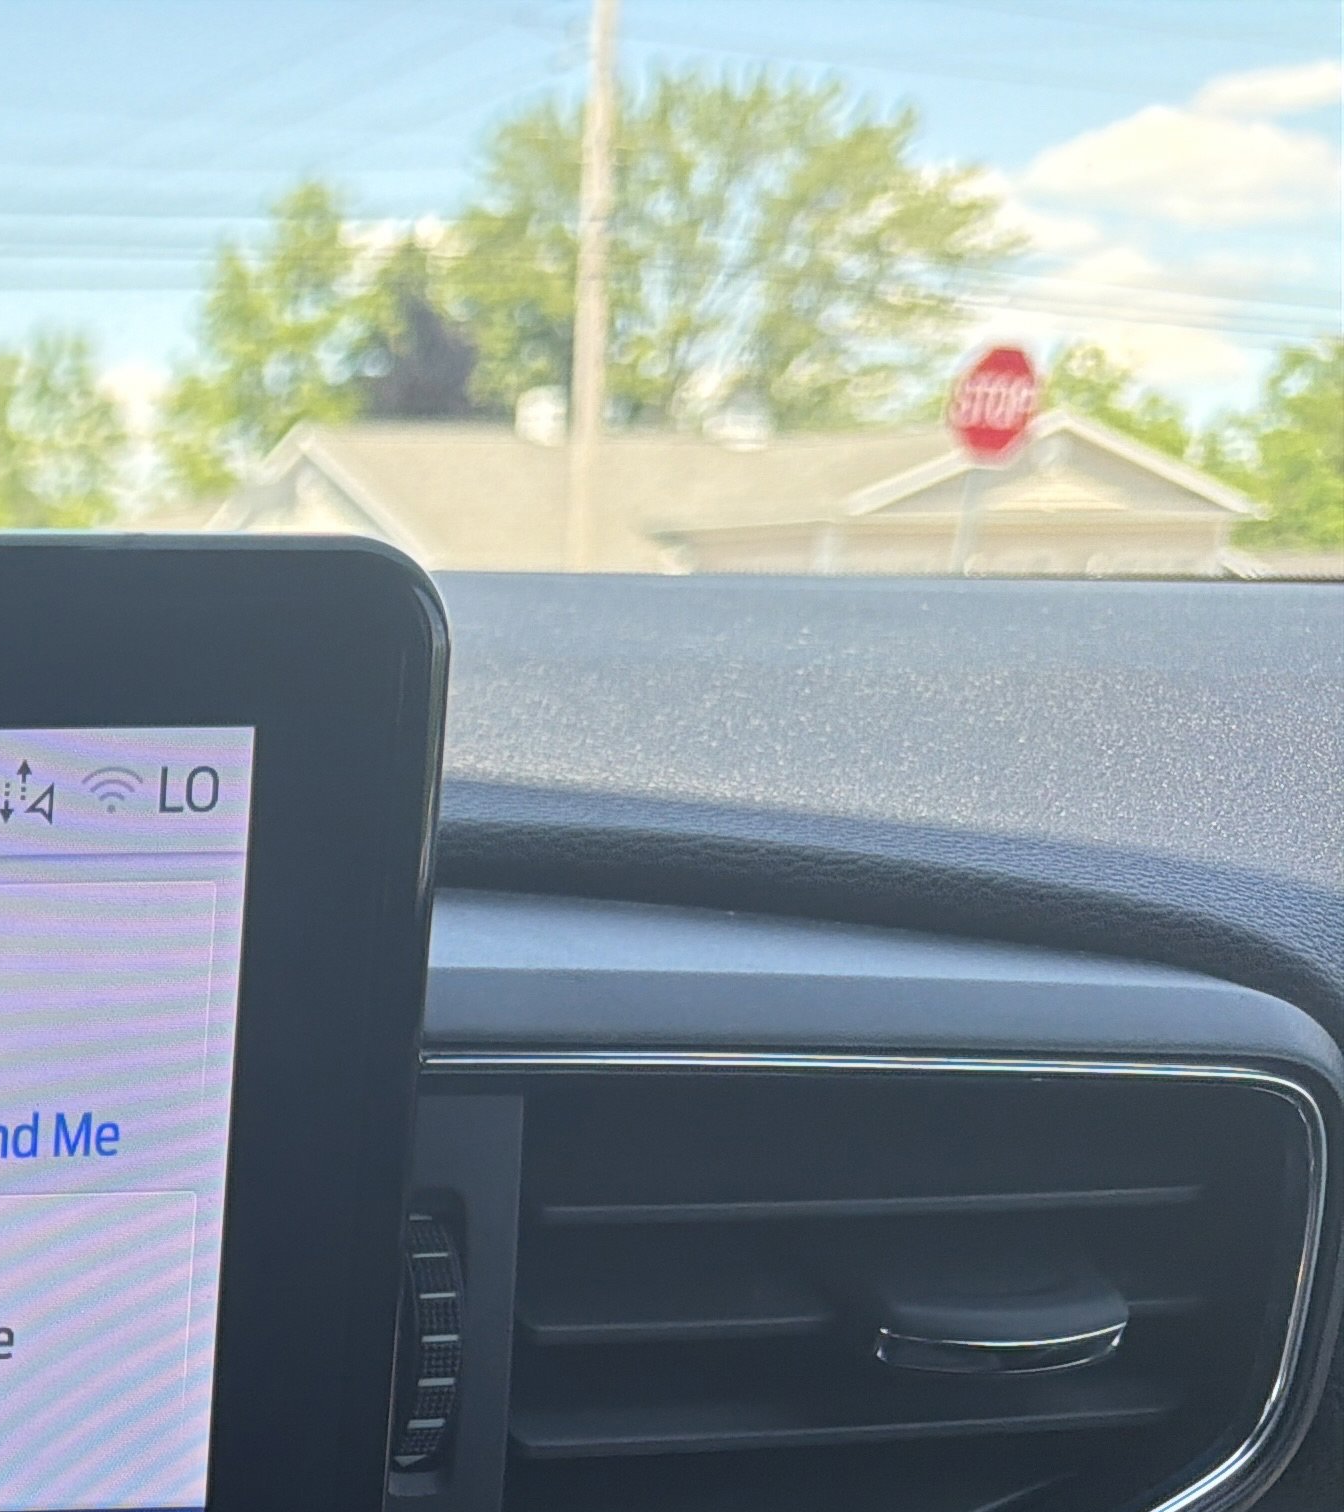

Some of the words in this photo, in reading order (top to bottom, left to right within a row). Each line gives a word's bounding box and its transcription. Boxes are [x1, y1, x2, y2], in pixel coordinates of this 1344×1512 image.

[952, 374, 1034, 429] STOP
[158, 765, 221, 814] LO
[52, 1113, 121, 1158] Me
